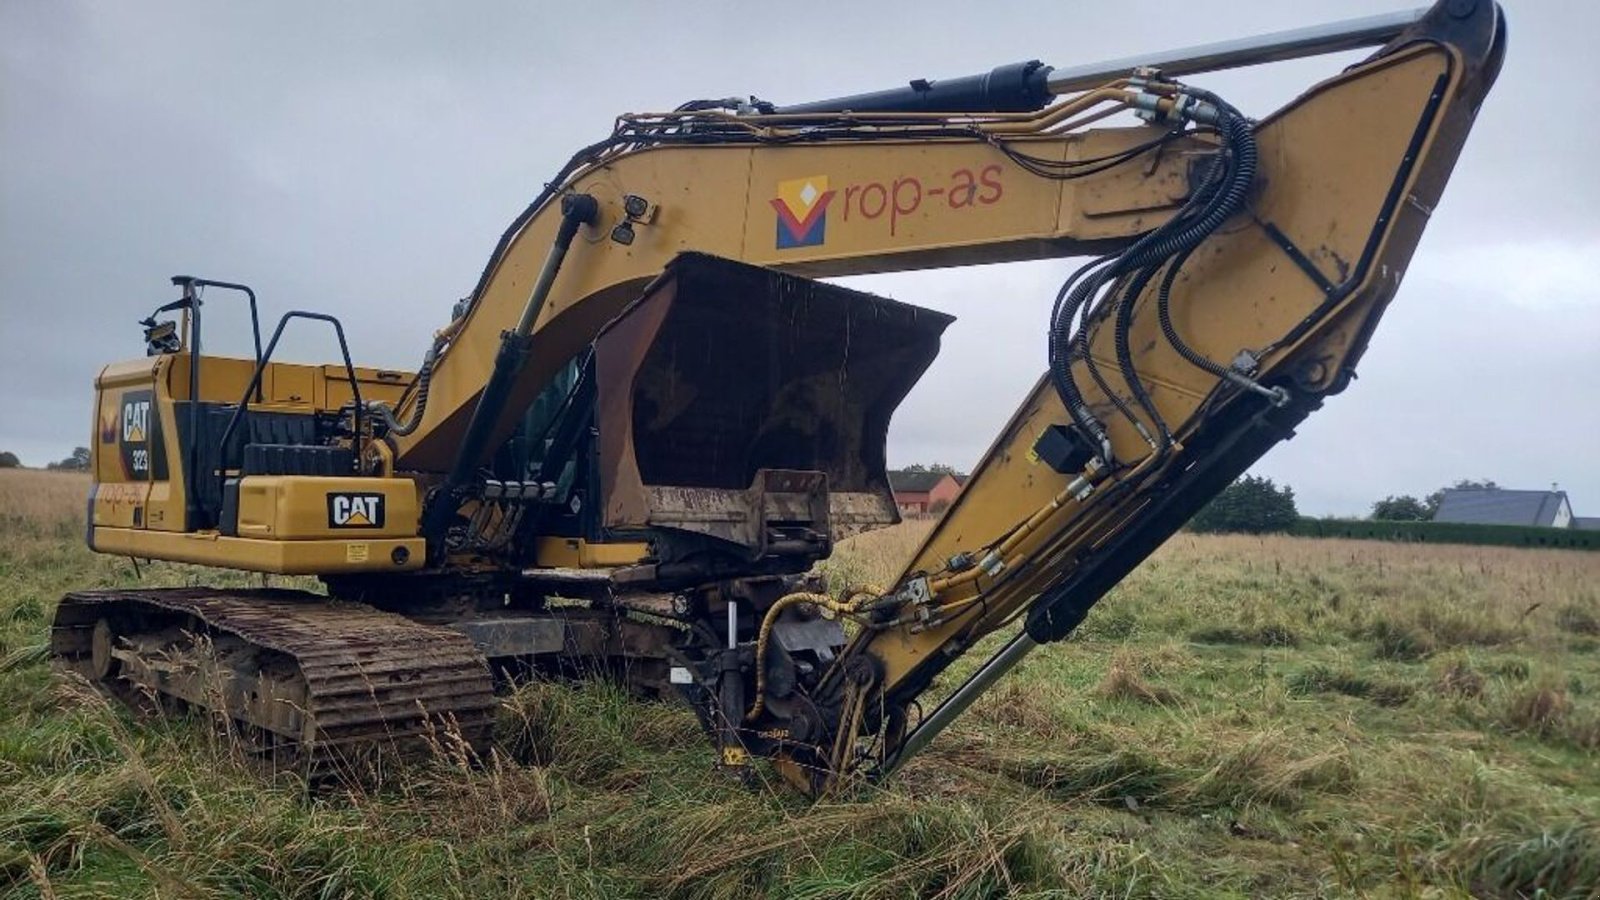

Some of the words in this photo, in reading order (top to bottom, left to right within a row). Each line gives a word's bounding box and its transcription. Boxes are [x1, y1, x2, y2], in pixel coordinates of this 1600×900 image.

[123, 401, 150, 442] CAT
[132, 449, 149, 471] 323
[334, 496, 379, 526] CAT
